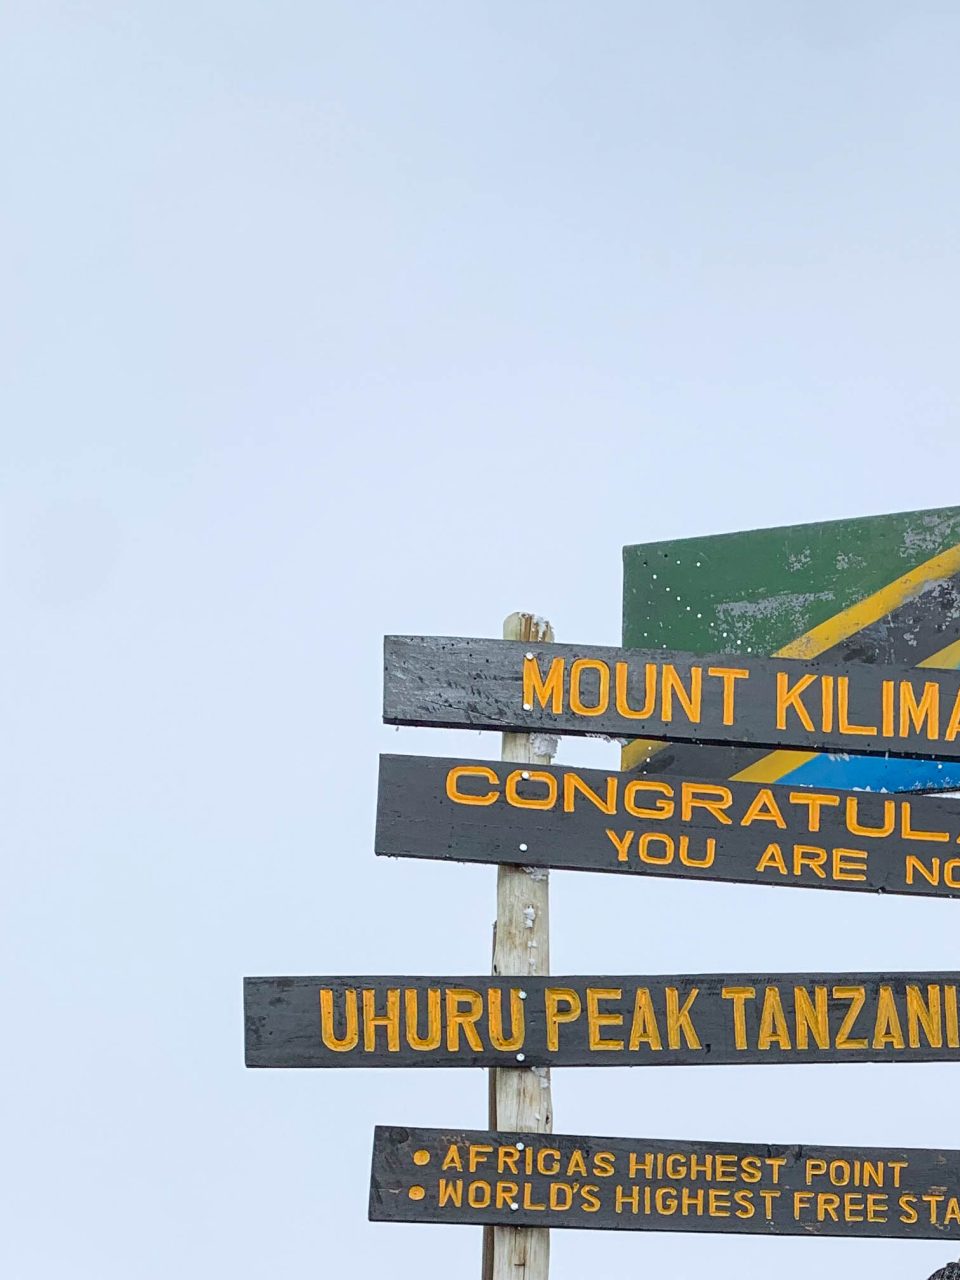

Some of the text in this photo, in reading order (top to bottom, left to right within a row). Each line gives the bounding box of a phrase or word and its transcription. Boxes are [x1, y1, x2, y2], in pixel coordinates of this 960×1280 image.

[523, 657, 749, 726] MOUNT
[607, 829, 716, 868] YOU
[756, 843, 867, 881] ARE
[320, 988, 525, 1052] UHURU
[629, 1153, 785, 1184] HIGHEST
[806, 1159, 905, 1187] POINT
[439, 1179, 601, 1212] WORLD'S
[616, 1185, 779, 1218] HIGHEST
[794, 1191, 886, 1222] FREE
